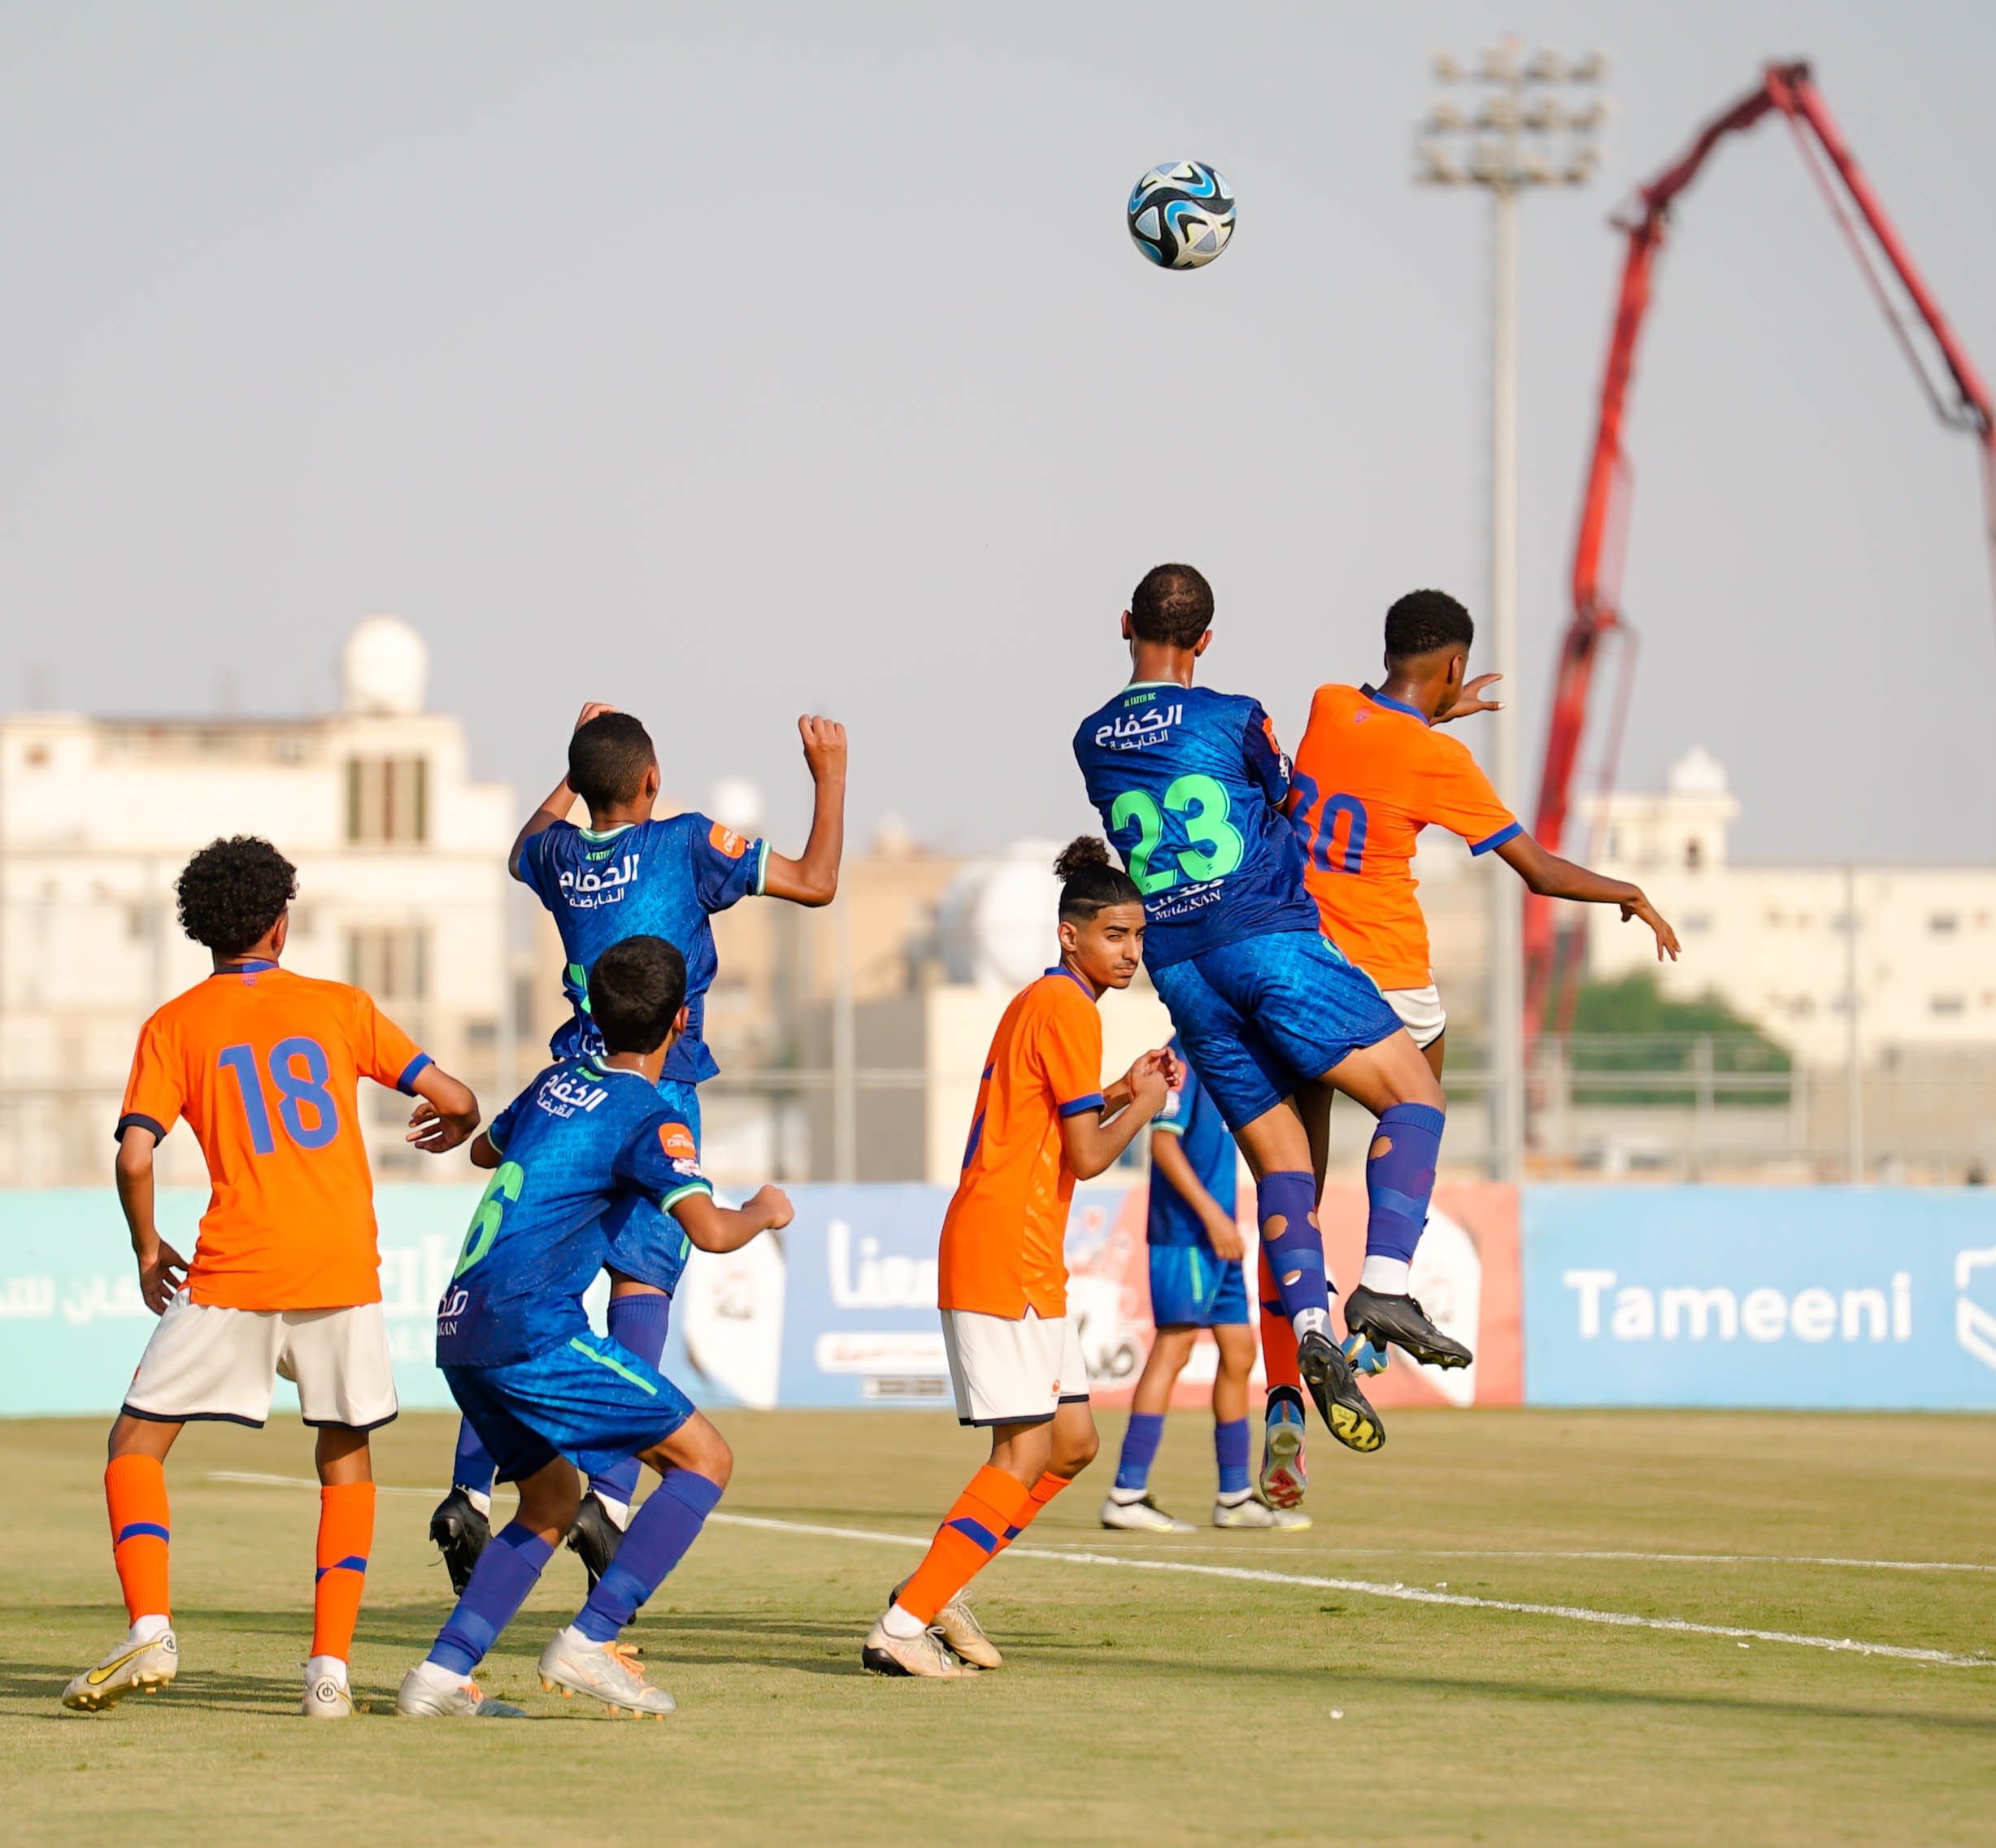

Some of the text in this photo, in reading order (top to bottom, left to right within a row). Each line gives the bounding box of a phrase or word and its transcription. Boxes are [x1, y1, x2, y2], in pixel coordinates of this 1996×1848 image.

[1095, 704, 1183, 747] الكفاح
[1147, 692, 1156, 701] SC
[1110, 729, 1169, 751] القابضة
[1111, 774, 1245, 896] 23
[217, 1037, 340, 1156] 18
[1562, 1269, 1912, 1343] Tameeni
